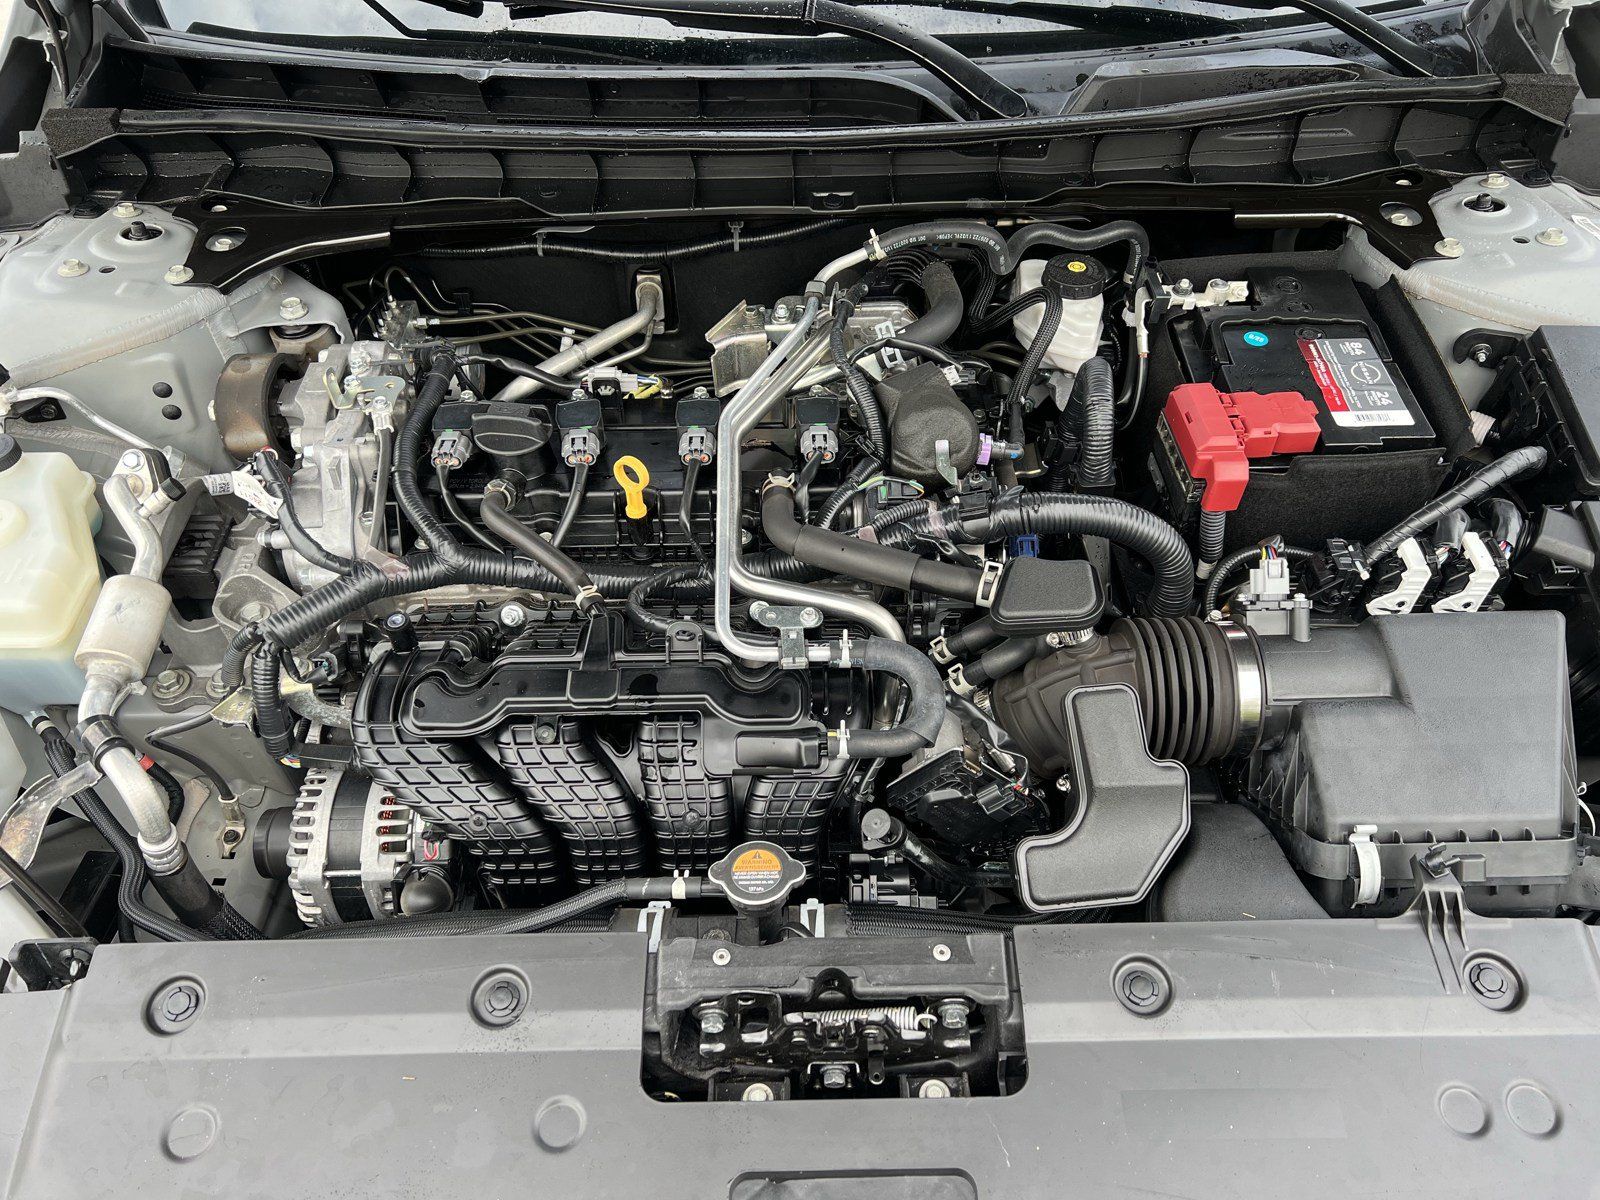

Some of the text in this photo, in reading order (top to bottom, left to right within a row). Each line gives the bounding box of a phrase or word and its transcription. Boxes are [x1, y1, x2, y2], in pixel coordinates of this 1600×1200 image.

[1350, 342, 1367, 356] 84
[1358, 361, 1374, 385] NISSAN
[1375, 391, 1394, 406] 24
